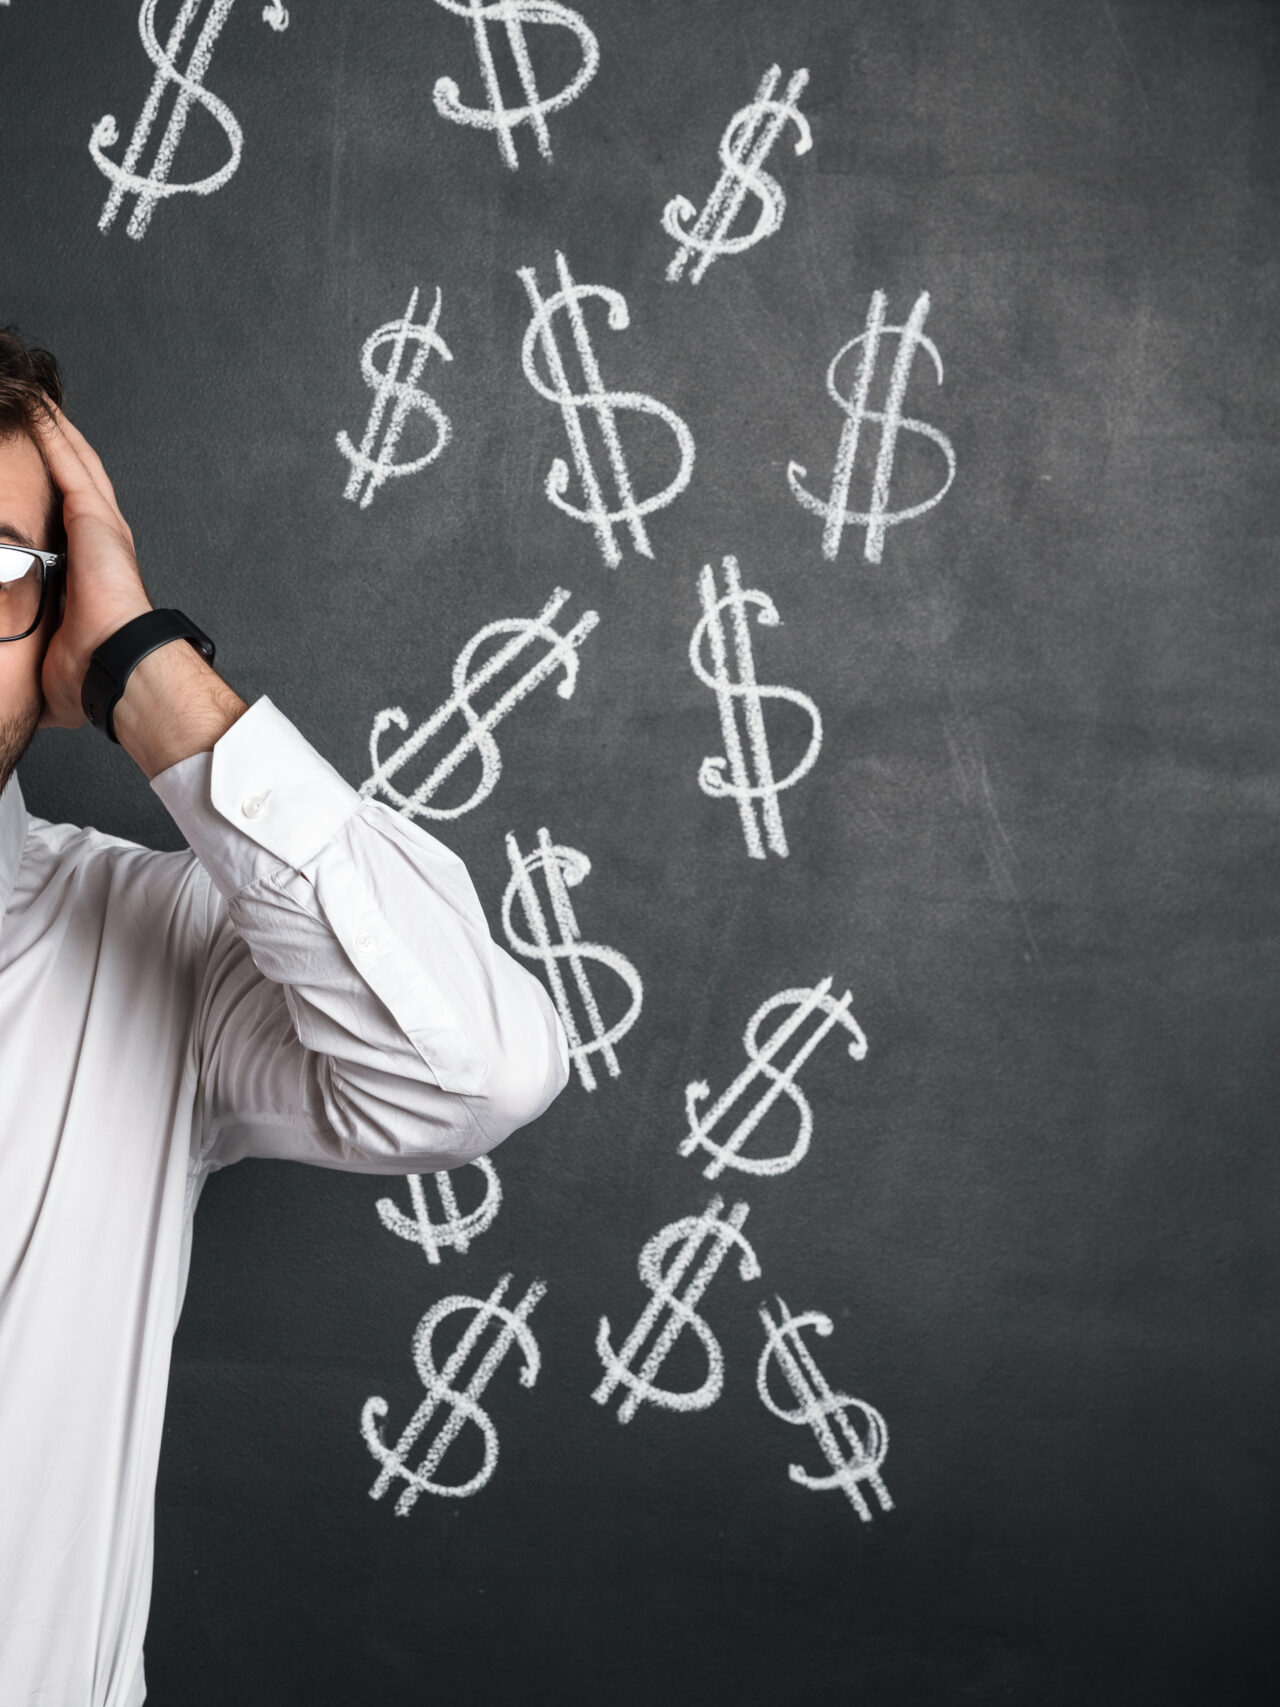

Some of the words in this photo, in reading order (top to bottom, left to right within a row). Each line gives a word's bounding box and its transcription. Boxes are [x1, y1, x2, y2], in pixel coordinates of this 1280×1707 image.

[89, 0, 289, 241] $
[661, 64, 814, 285] $
[337, 287, 454, 509] $
[517, 251, 697, 569] $
[788, 290, 957, 565] $
[360, 588, 601, 819] $
[690, 556, 824, 860] $
[499, 827, 644, 1091] $
[679, 977, 869, 1181] $
[361, 1274, 548, 1517] $
[592, 1196, 762, 1425] $
[757, 1298, 895, 1523] $
